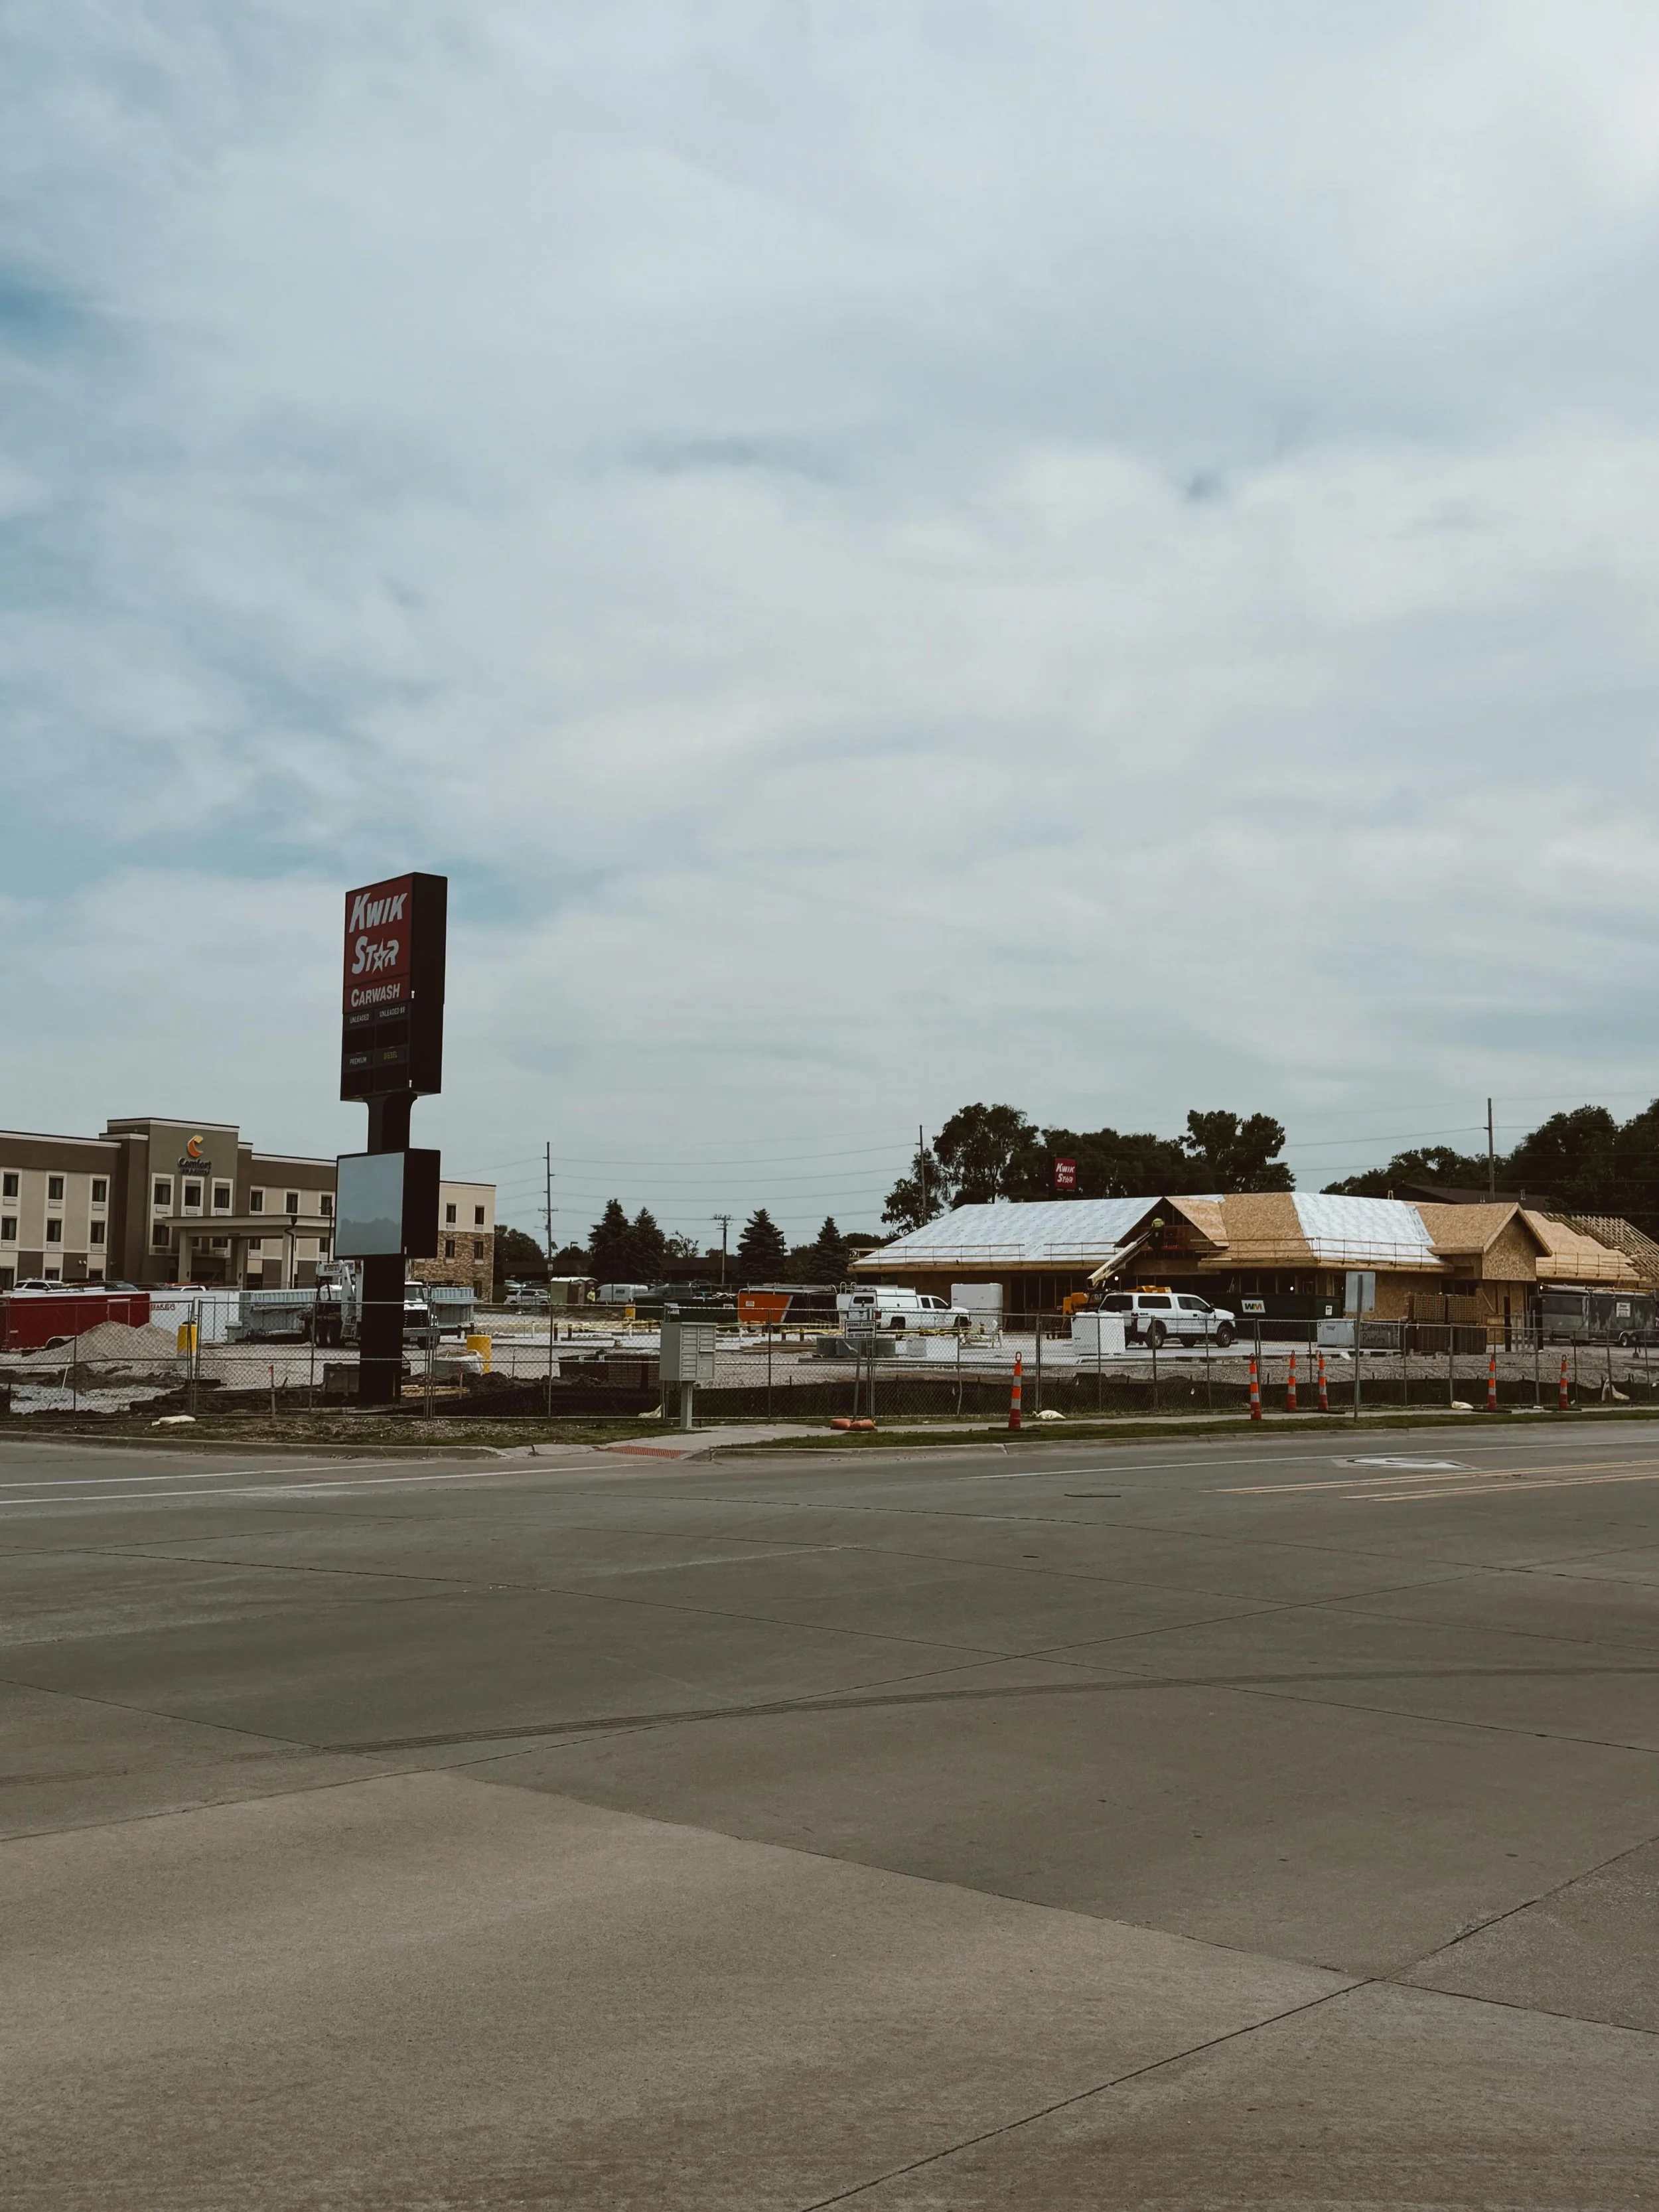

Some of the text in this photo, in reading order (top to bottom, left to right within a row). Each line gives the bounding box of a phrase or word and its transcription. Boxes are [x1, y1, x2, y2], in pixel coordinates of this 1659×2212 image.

[348, 892, 408, 933] KWIK
[350, 982, 401, 1007] CARWASH
[379, 1007, 399, 1018] UNLEADED
[349, 1013, 370, 1023] UNLEADED
[349, 1056, 367, 1065] PREMIUM
[383, 1051, 397, 1060] DIESEL
[178, 1157, 212, 1169] Comfort
[1056, 1163, 1075, 1173] KWIK
